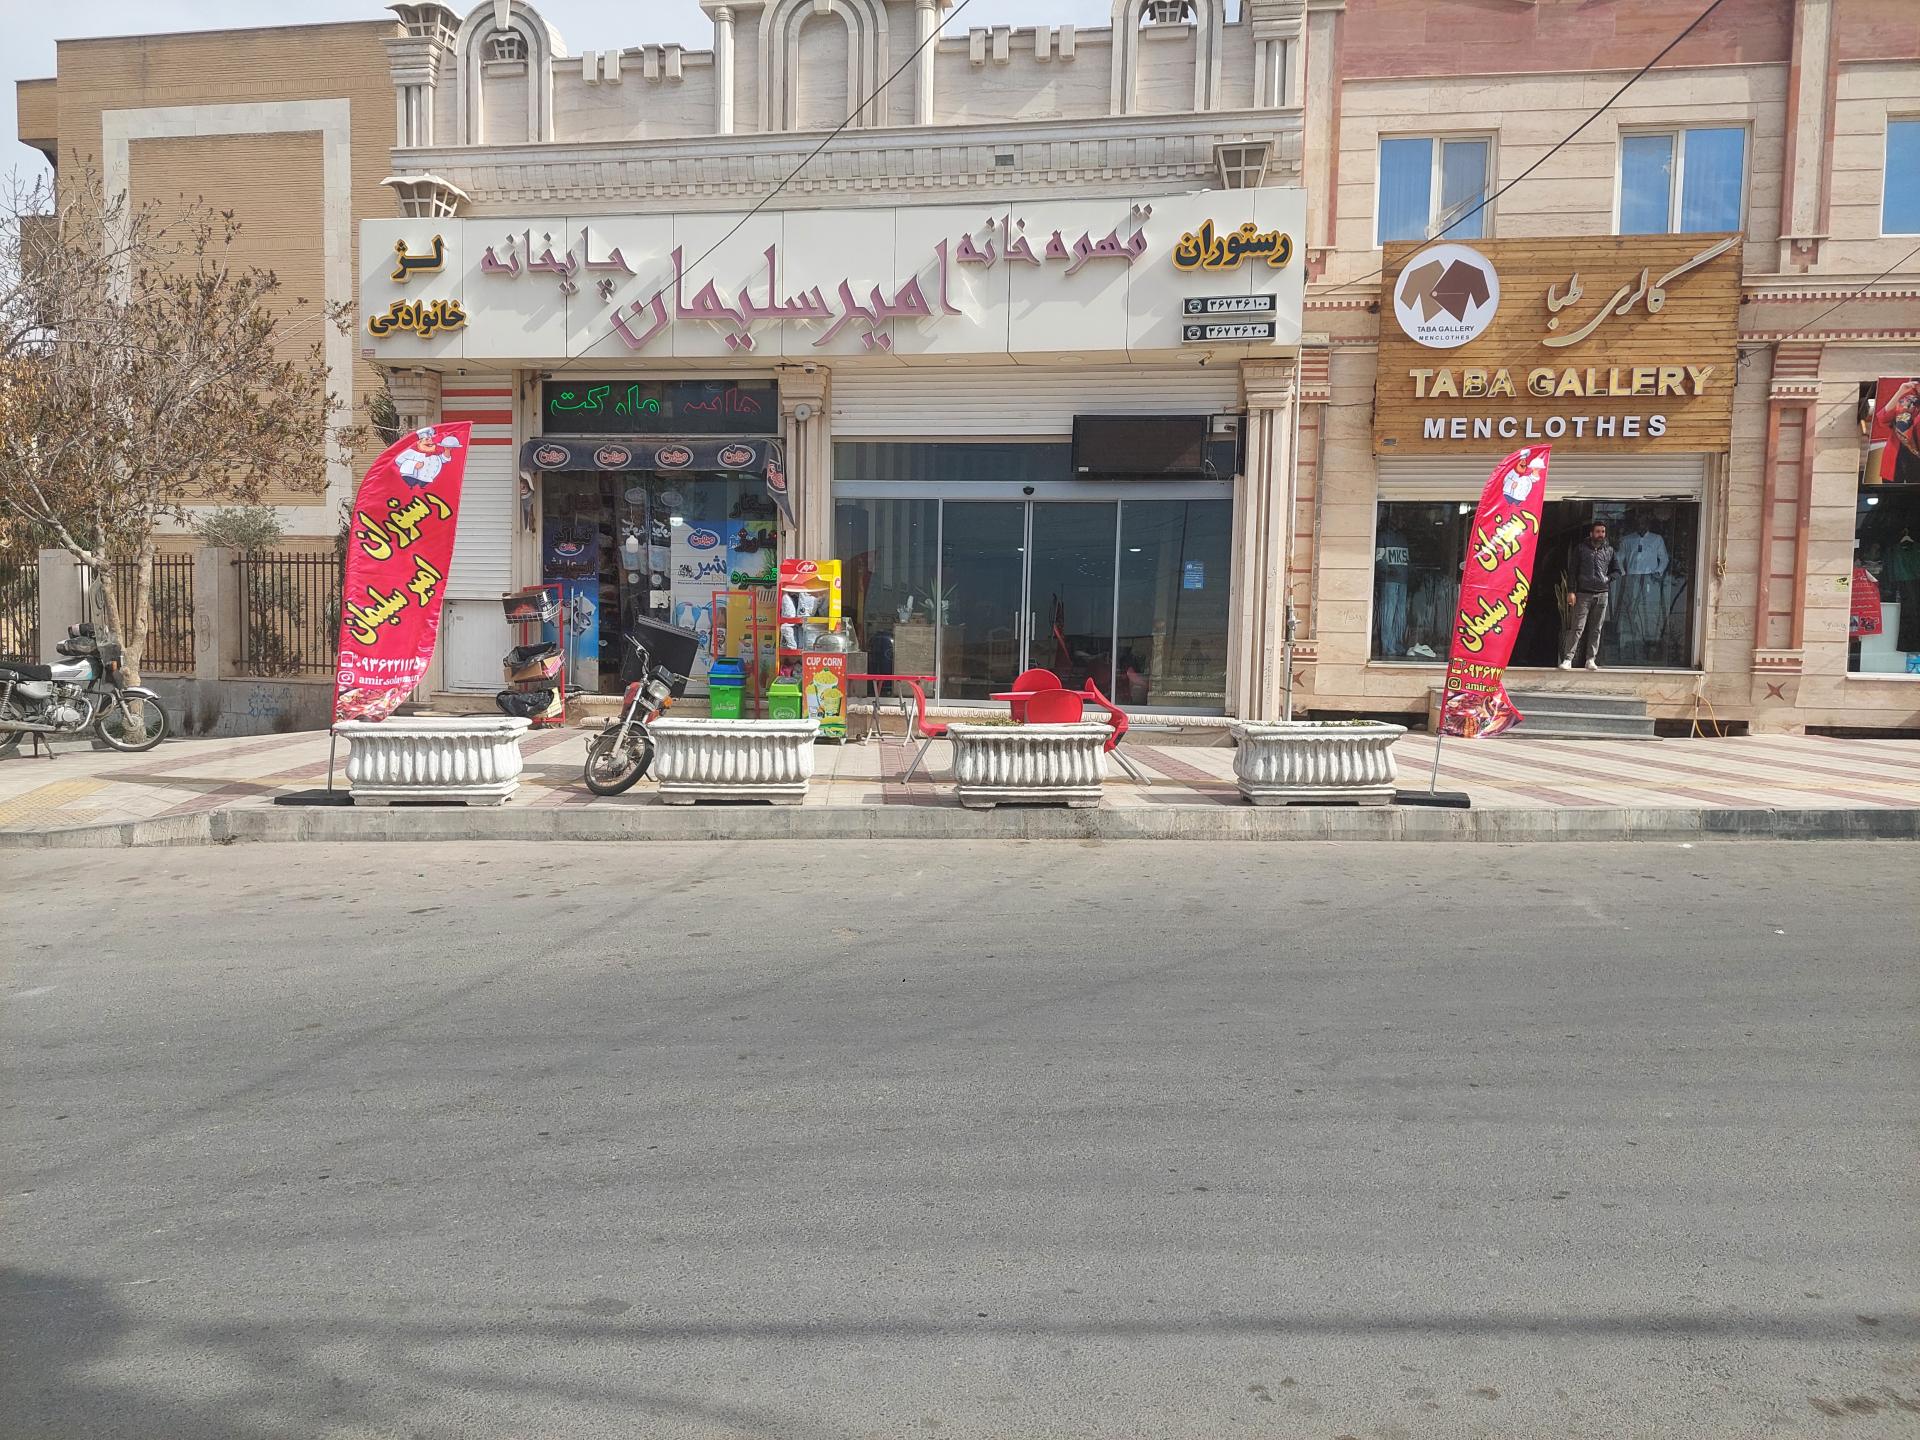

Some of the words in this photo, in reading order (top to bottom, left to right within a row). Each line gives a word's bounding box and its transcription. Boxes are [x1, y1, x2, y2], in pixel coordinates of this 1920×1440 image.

[389, 233, 444, 283] لژ
[955, 213, 1041, 269] خانه
[1045, 203, 1153, 276] قهوه
[1171, 218, 1294, 273] رستوران
[367, 299, 468, 341] خانوادگی
[1417, 325, 1438, 334] TABA
[1439, 324, 1475, 333] GALLERY
[1409, 368, 1517, 398] TABA
[1527, 365, 1715, 398] GALLERY
[1423, 414, 1667, 439] MENCLOTHES
[356, 492, 453, 561] رستوران
[1473, 510, 1539, 572] رستوران
[406, 554, 443, 608] امیر
[1507, 566, 1531, 618] امیر
[344, 585, 410, 646] سلیمان
[1457, 597, 1510, 653] سلیمان
[806, 656, 821, 666] CUP
[822, 657, 843, 667] CORN
